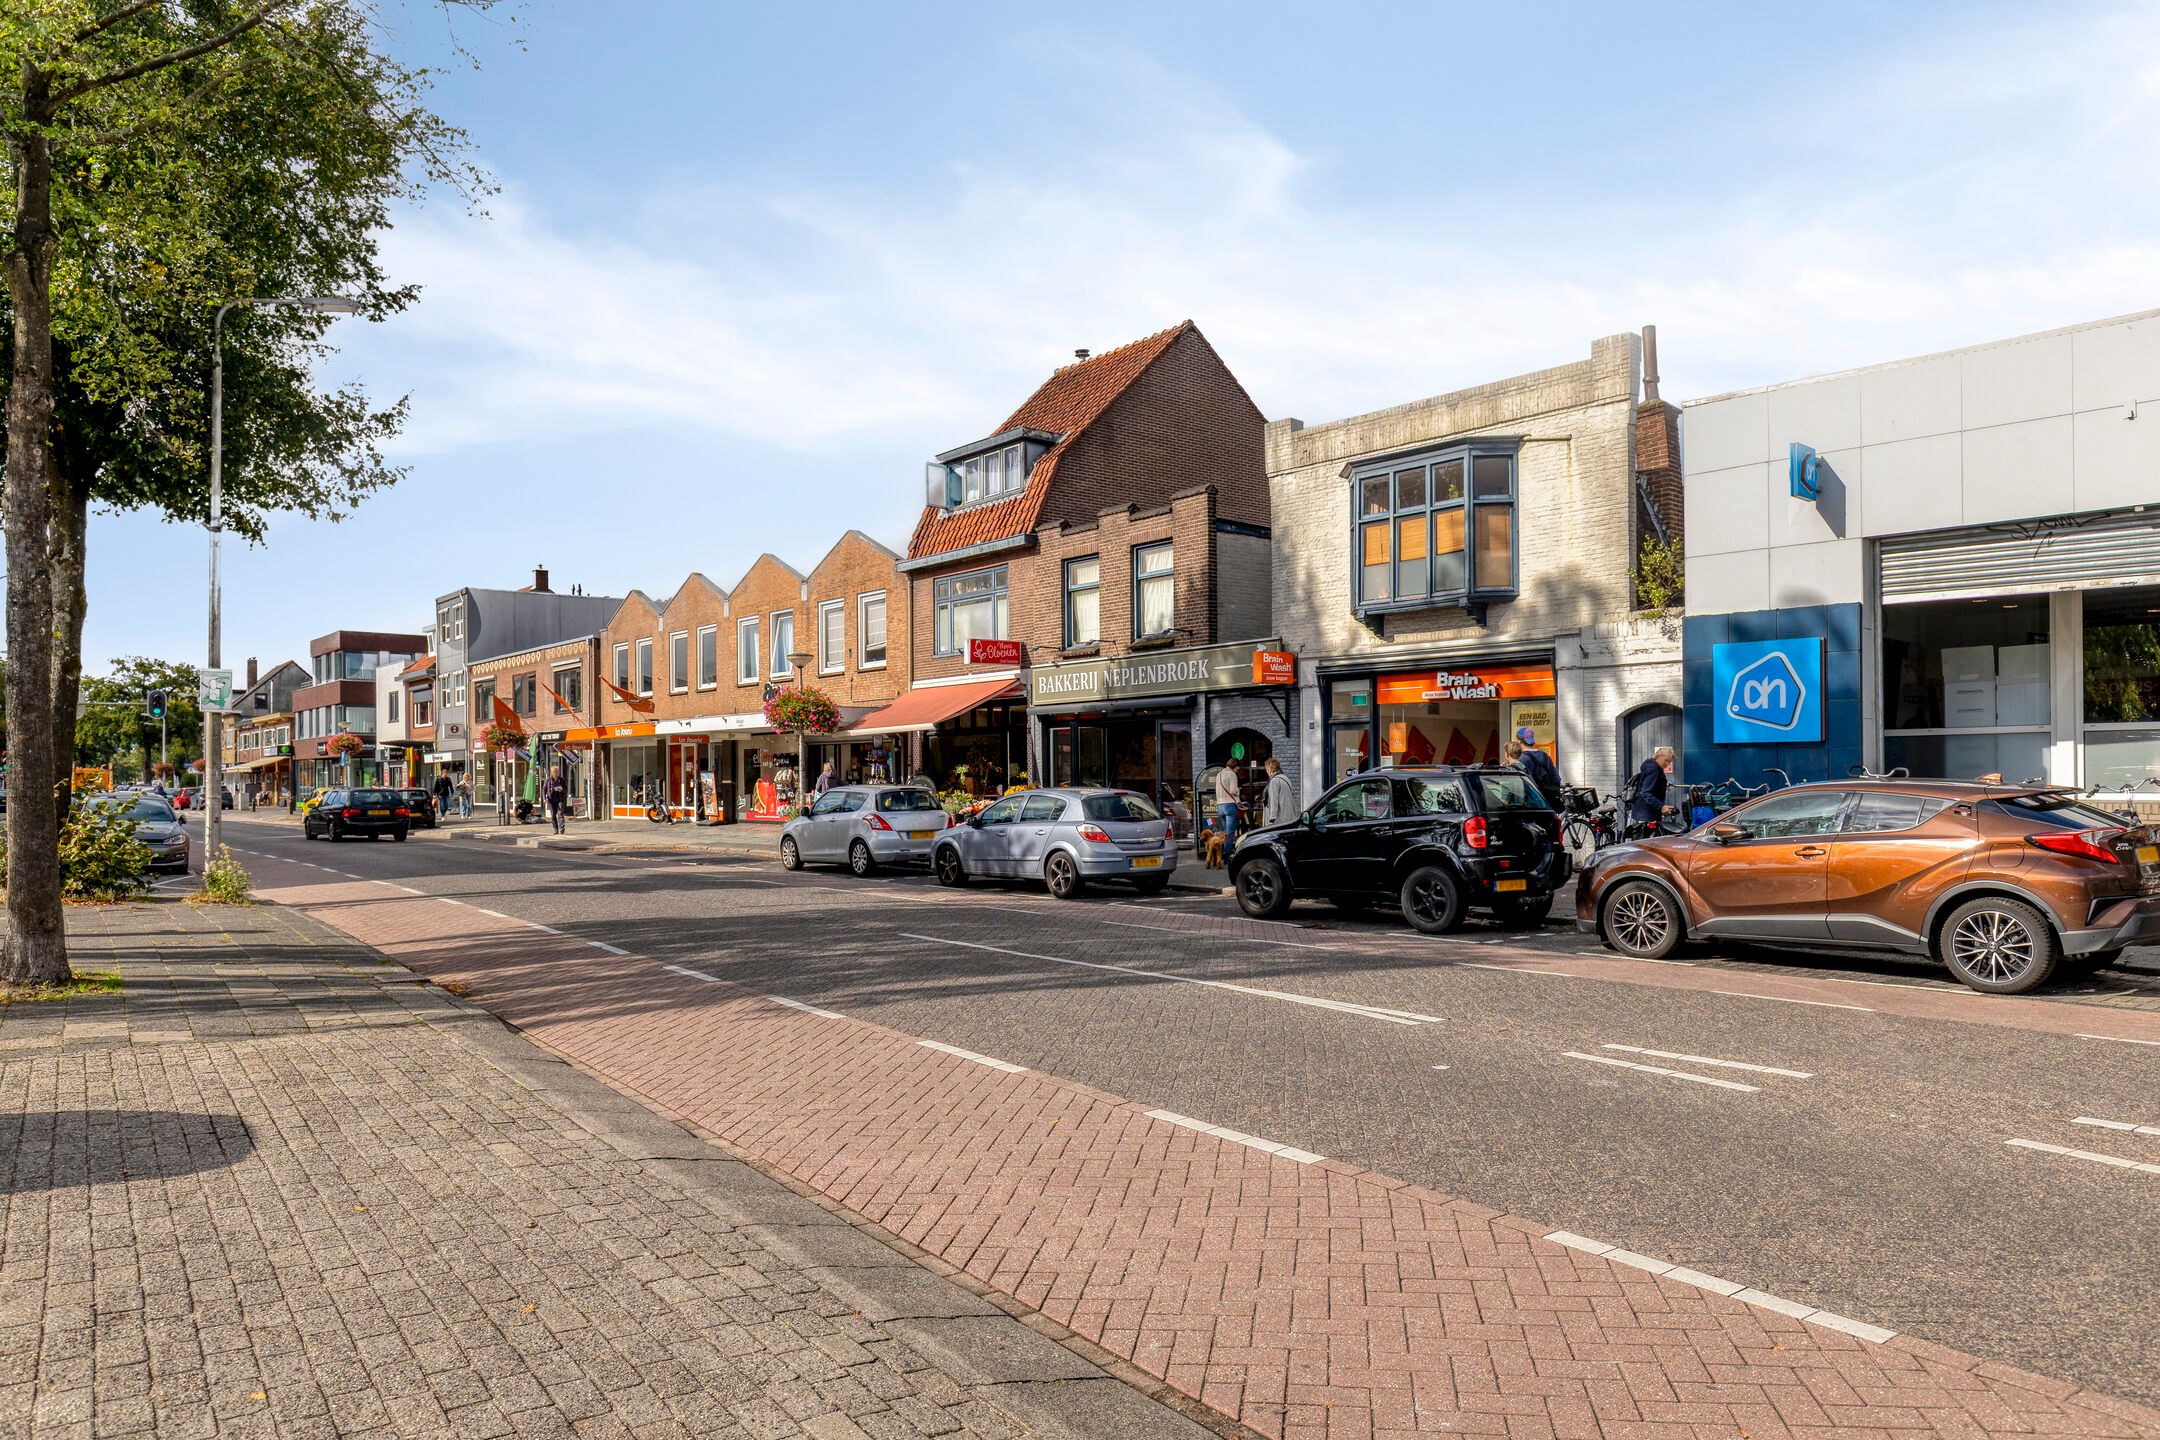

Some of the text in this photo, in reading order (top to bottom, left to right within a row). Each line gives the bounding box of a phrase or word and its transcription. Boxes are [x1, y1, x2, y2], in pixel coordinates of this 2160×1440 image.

[986, 644, 1018, 659] Bloemen
[1263, 653, 1283, 663] Brain
[1103, 659, 1210, 688] NEPLENBROEK
[1270, 663, 1292, 672] Wash
[1038, 670, 1098, 694] BAKKERIJ
[1436, 671, 1479, 687] Brain
[1451, 683, 1497, 700] Wash
[1533, 719, 1550, 727] DAY?
